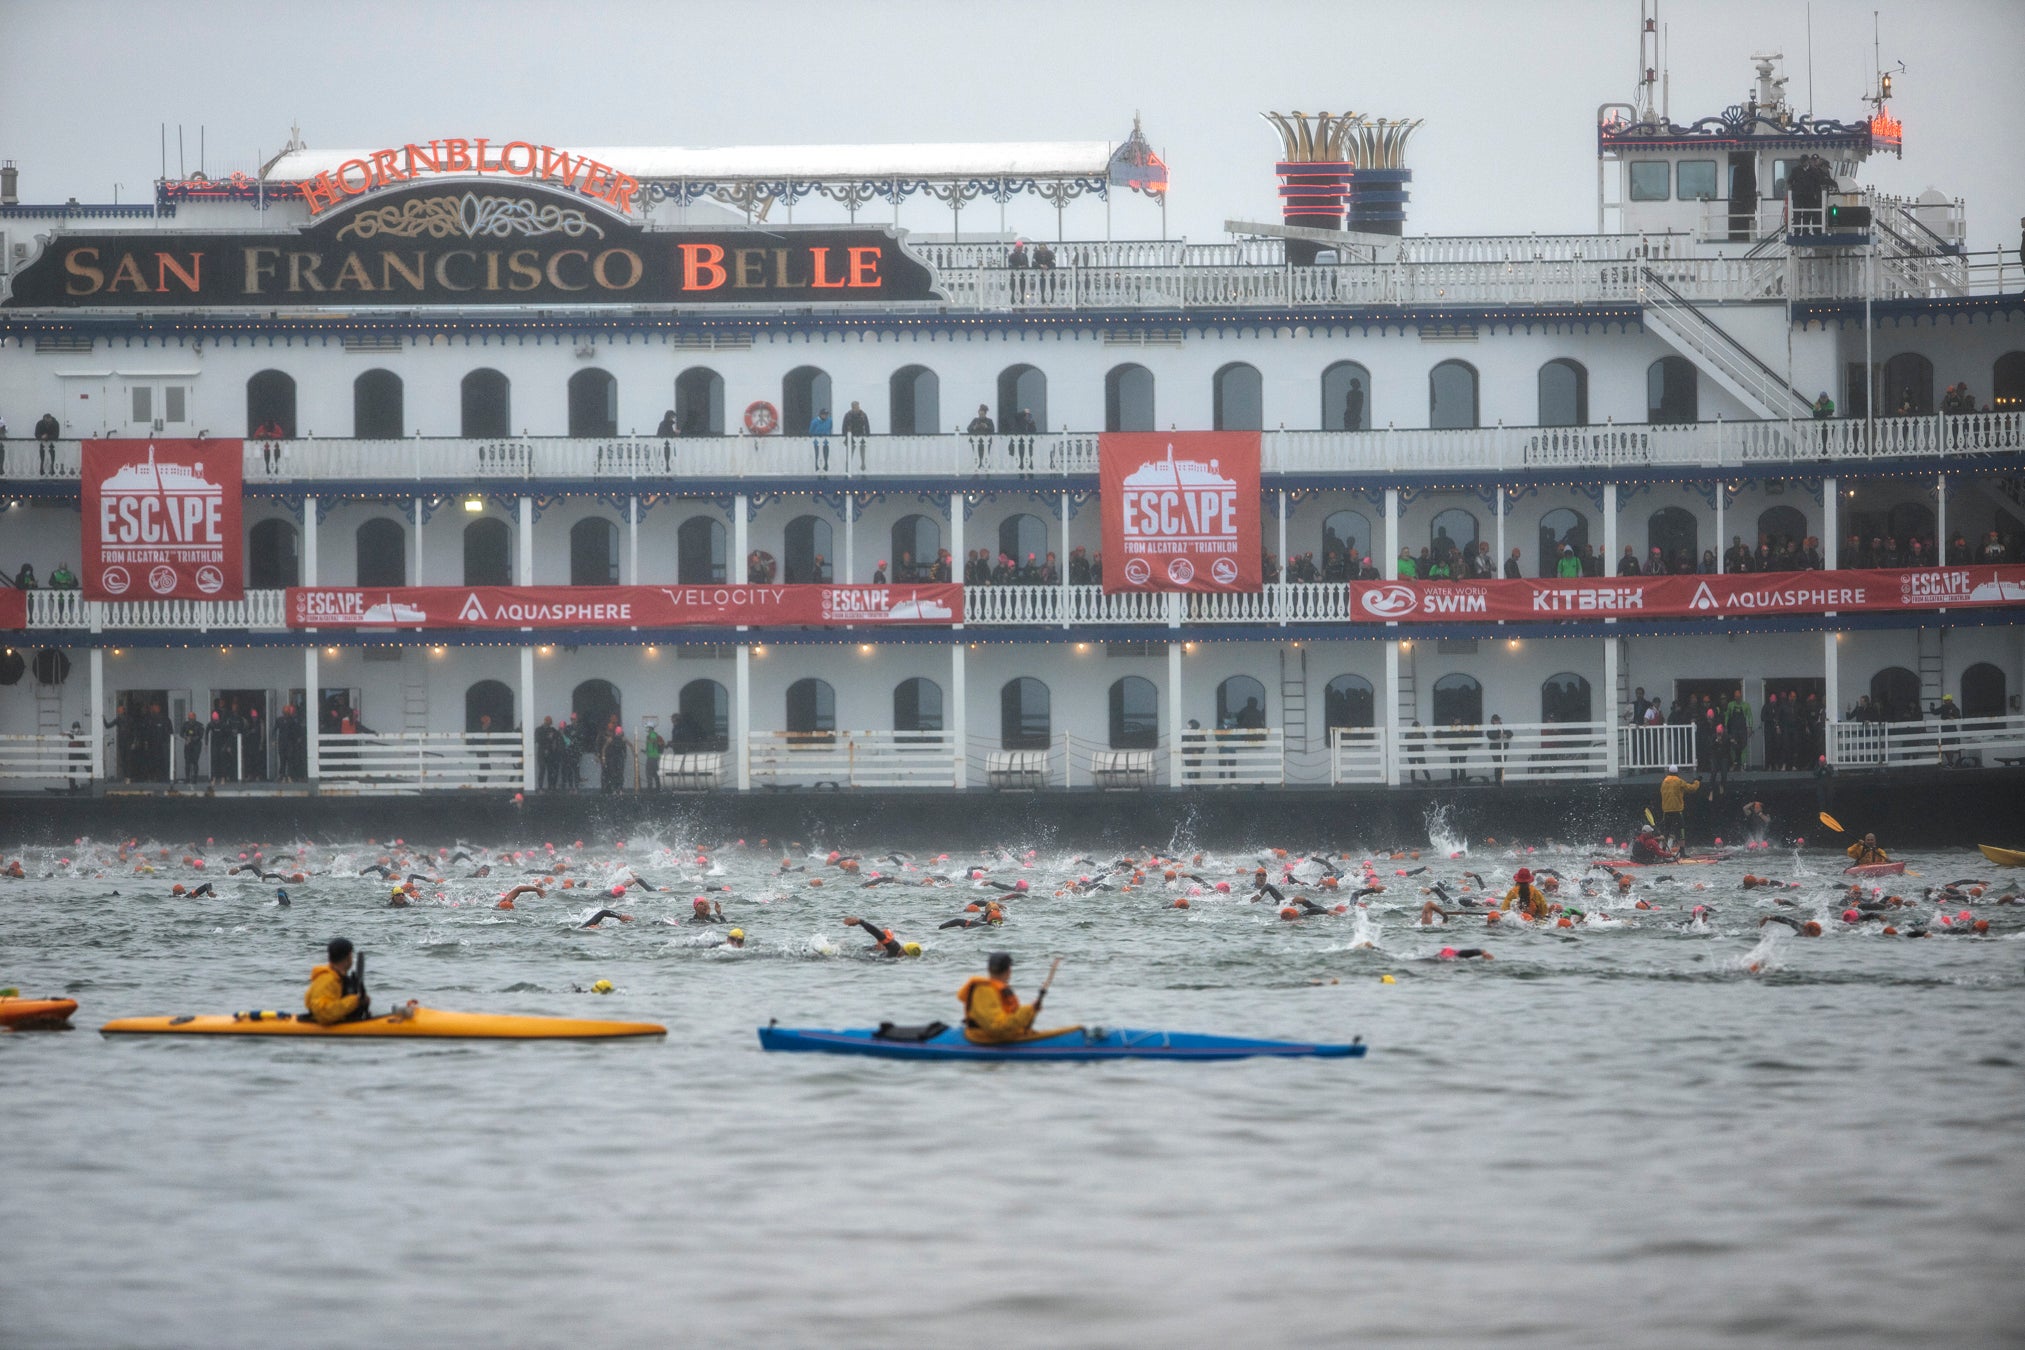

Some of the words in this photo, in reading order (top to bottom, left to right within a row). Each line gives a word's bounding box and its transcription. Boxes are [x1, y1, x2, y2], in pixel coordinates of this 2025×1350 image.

[300, 138, 640, 215] HORNBLOWER
[64, 247, 205, 296] SAN
[242, 244, 644, 295] FRANCISCO
[677, 243, 883, 291] BELLE
[100, 496, 223, 543] ESCAPE
[1123, 491, 1237, 535] ESCAPE
[101, 550, 125, 563] FROM
[126, 550, 171, 563] ALCATRAZ
[177, 550, 224, 563] TRIATHLON
[1124, 541, 1146, 554] FROM
[1147, 541, 1188, 554] ALCATRAZ
[1194, 541, 1238, 553] TRIATHLON
[1423, 588, 1452, 597] WATER
[1455, 587, 1488, 596] WORLD
[1911, 571, 1970, 595] ESCAPE
[306, 592, 364, 614] ESCAPE
[664, 588, 785, 605] VELOCITY
[832, 590, 889, 611] ESCAPE
[1423, 595, 1487, 613] SWIM
[1726, 588, 1866, 608] AQUASPHERE
[494, 603, 632, 621] AQUASPHERE
